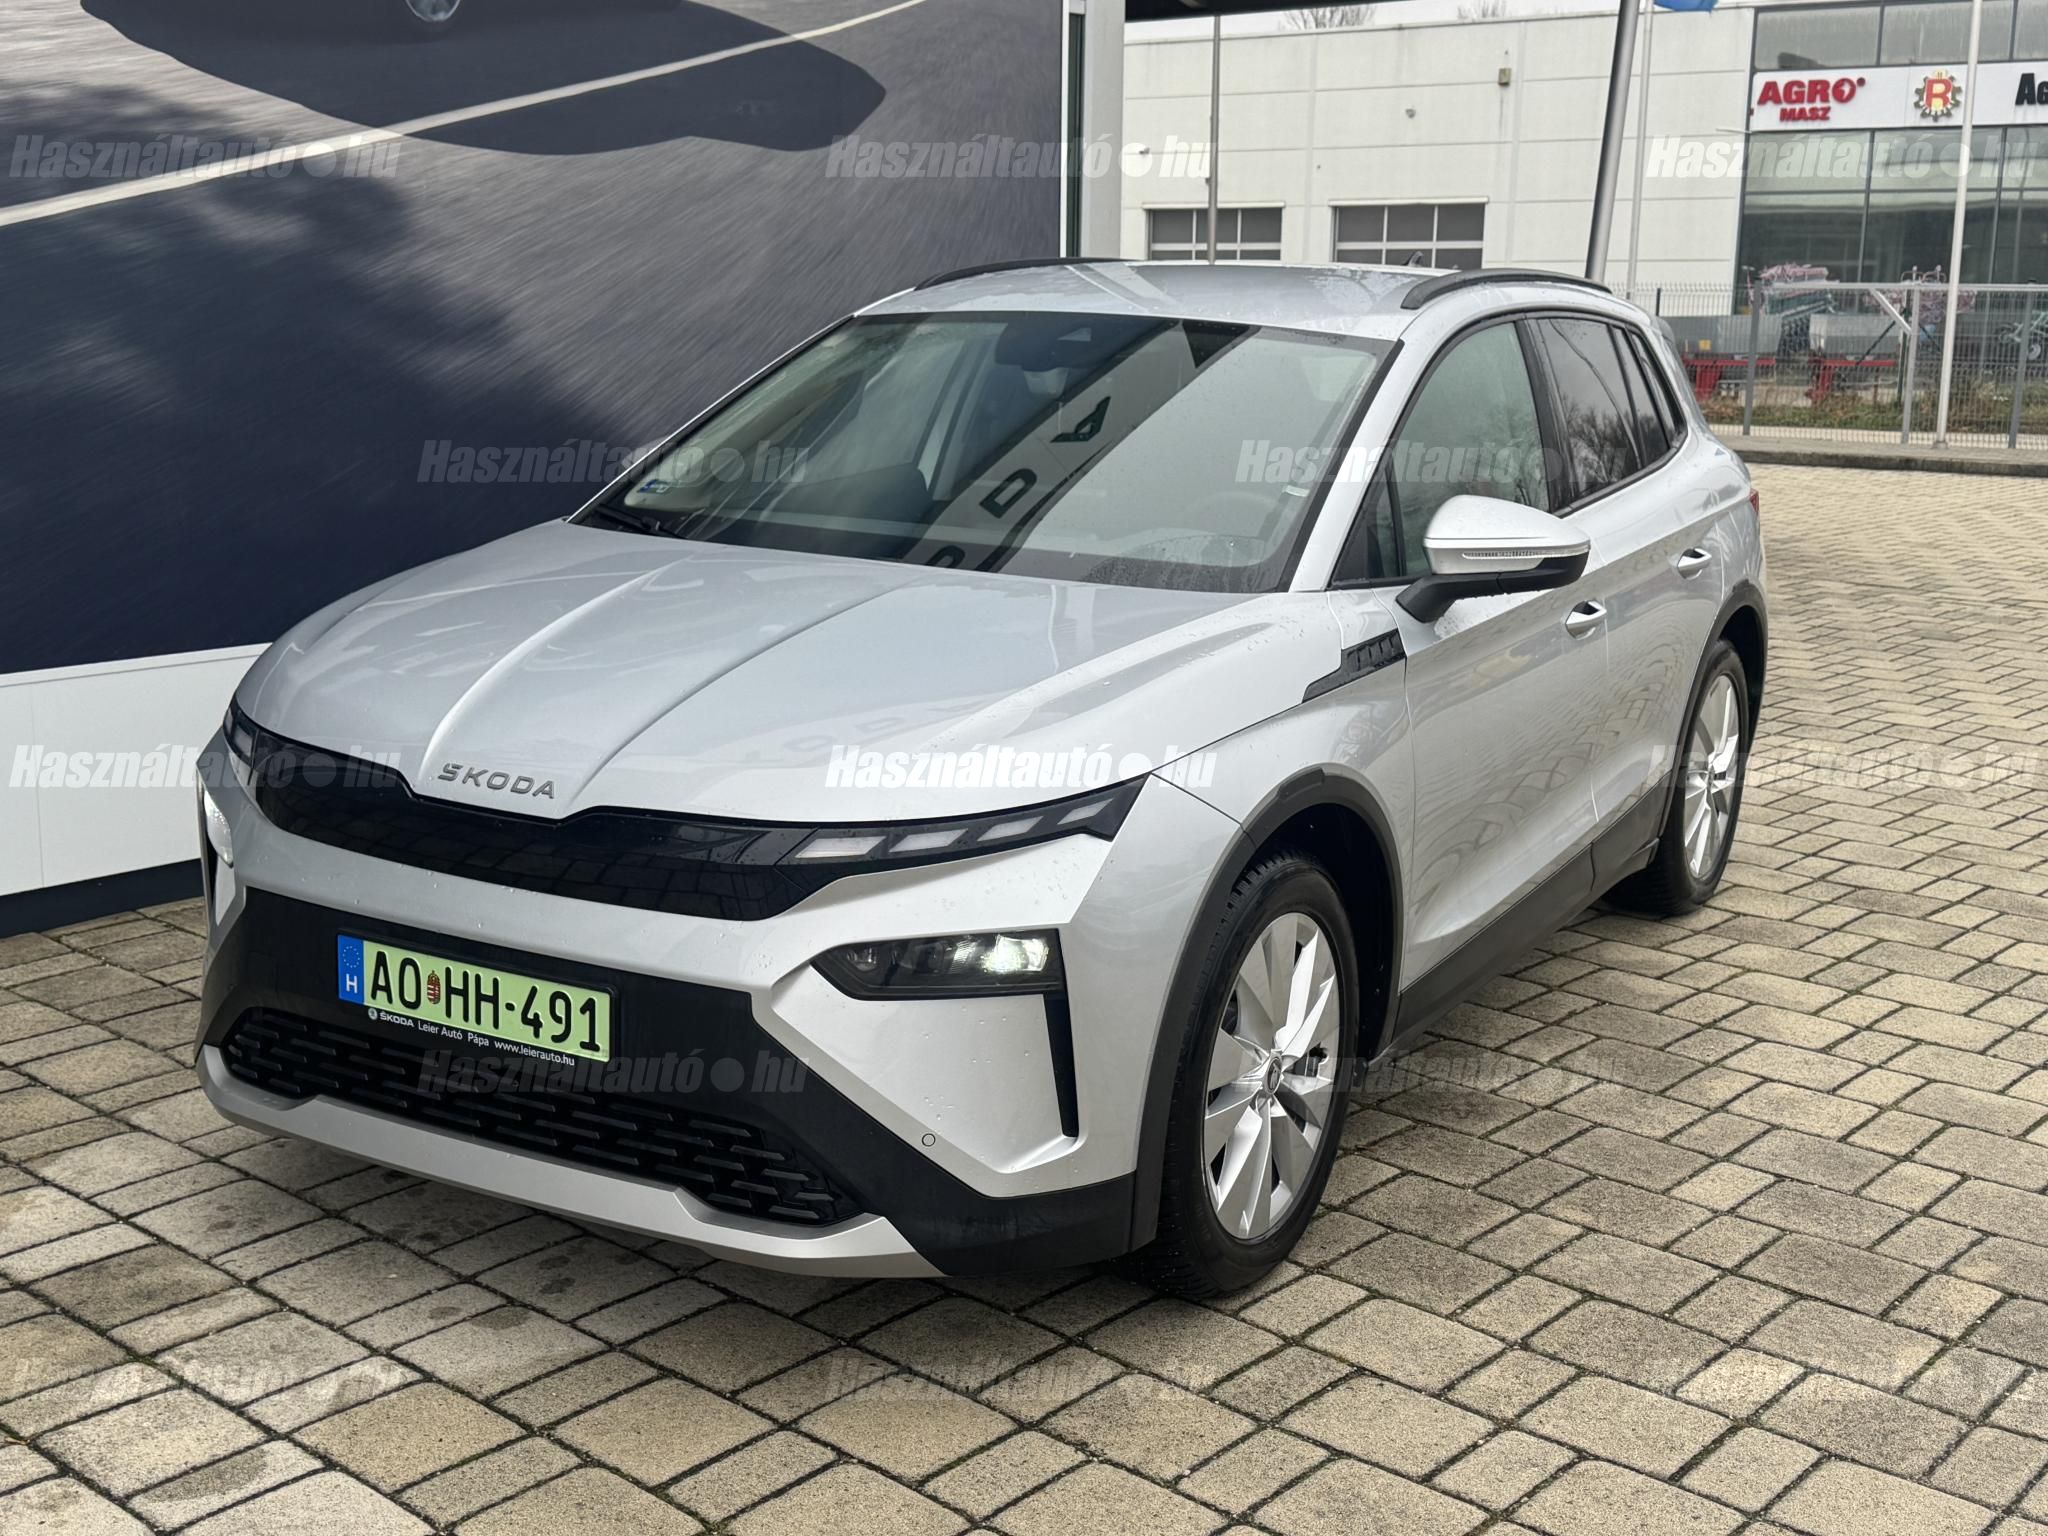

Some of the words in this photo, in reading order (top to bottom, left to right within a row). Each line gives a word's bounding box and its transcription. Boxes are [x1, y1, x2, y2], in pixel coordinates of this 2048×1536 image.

[1757, 77, 1857, 106] AGRO
[1779, 106, 1831, 122] MASZ
[345, 973, 358, 994] H
[380, 1011, 415, 1028] ŠKODA
[418, 1021, 439, 1034] Leier
[441, 1027, 463, 1040] Autó
[467, 1032, 489, 1047] Pápa
[494, 1041, 575, 1066] www.leierauto.hu
